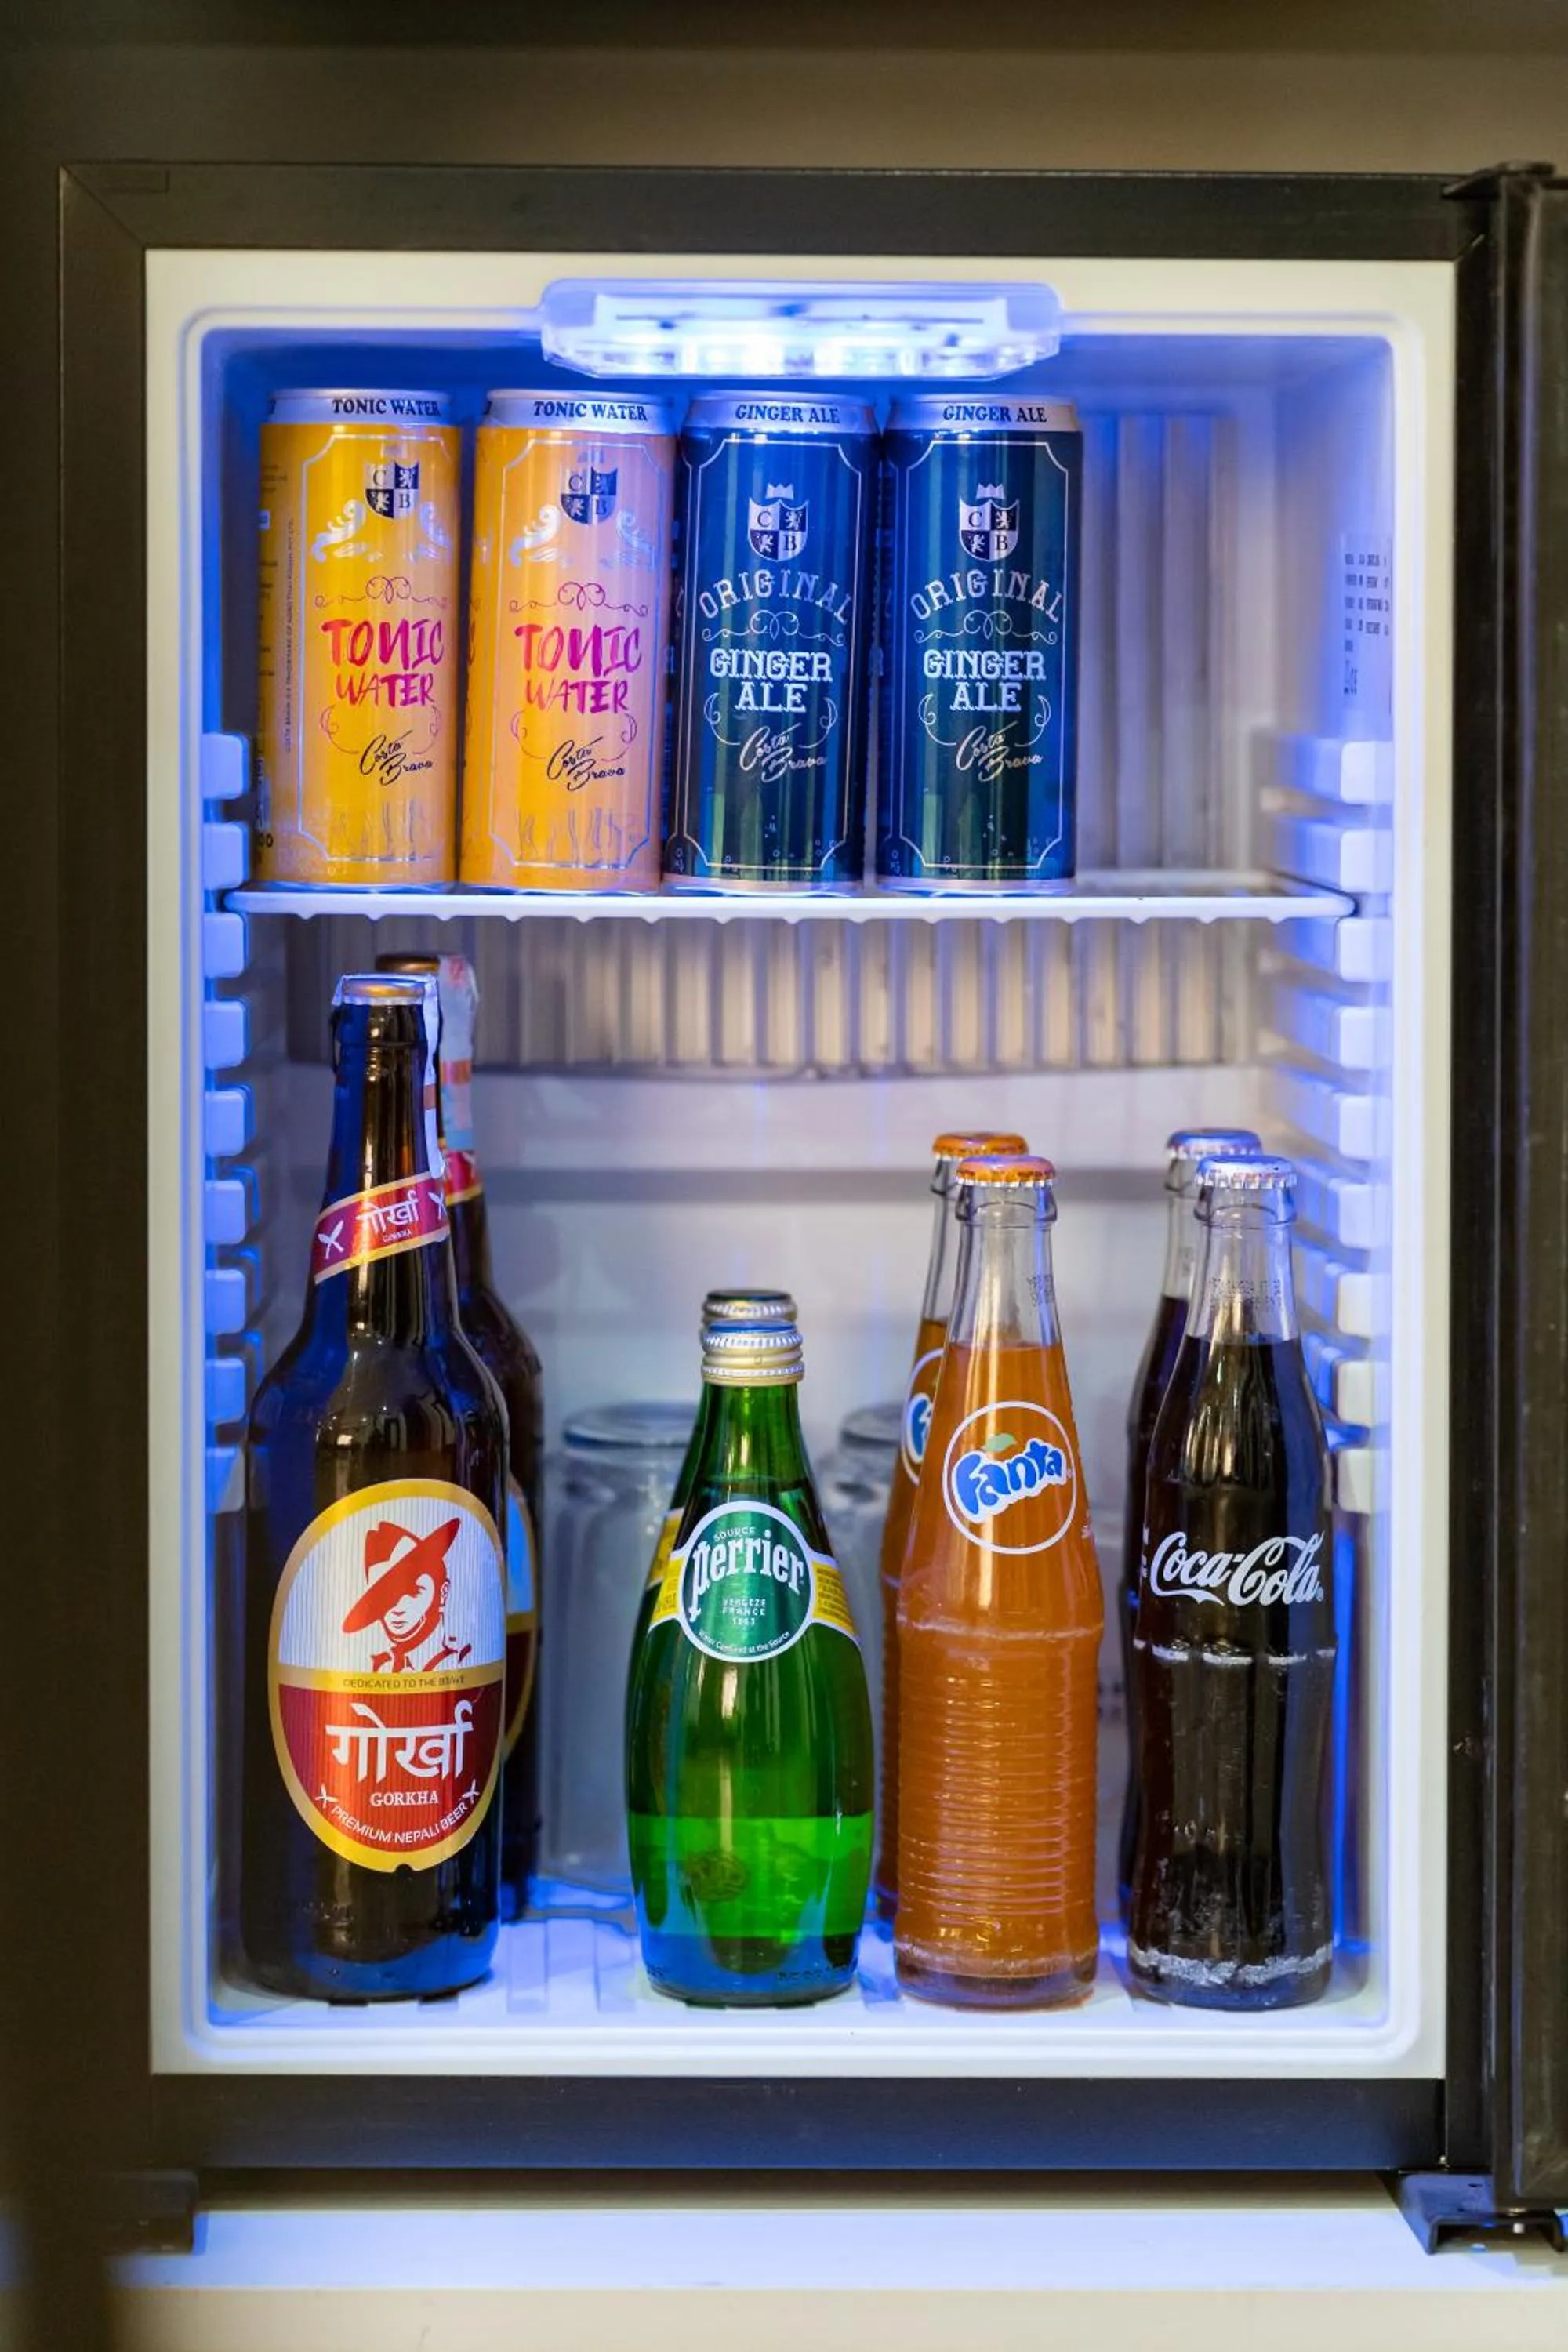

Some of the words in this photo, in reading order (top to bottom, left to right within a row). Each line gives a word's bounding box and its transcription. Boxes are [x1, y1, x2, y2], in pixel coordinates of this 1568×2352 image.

[332, 399, 387, 415] TONIC
[391, 400, 441, 416] WATER
[533, 401, 586, 417] TONIC
[592, 405, 648, 421] WATER
[735, 405, 804, 422] GINGER
[809, 407, 840, 423] ALE
[943, 405, 1011, 423] GINGER
[1016, 406, 1047, 423] ALE
[372, 470, 386, 486] C
[568, 475, 583, 492] C
[399, 493, 411, 509] B
[757, 510, 771, 528] C
[968, 511, 982, 528] C
[784, 535, 797, 551] B
[996, 535, 1008, 551] B
[699, 569, 851, 625] ORIGINAL
[910, 569, 1062, 623] ORIGINAL
[321, 619, 444, 670] TONIC
[514, 624, 642, 677] TONIC
[710, 648, 833, 682] GINGER
[924, 648, 1047, 681] GINGER
[336, 673, 434, 707] WATER
[526, 679, 628, 714] WATER
[735, 681, 808, 713] ALE
[950, 681, 1022, 712] ALE
[954, 1439, 1065, 1521] Fanta
[713, 1526, 756, 1542] SOURCE
[1150, 1530, 1325, 1606] Coca-Cola
[723, 1608, 766, 1617] FRANCE
[343, 1678, 401, 1690] DEDICATED
[403, 1679, 416, 1689] TO
[419, 1677, 437, 1687] THE
[370, 1790, 439, 1807] GORKHA
[331, 1805, 391, 1842] PREMIUM
[394, 1825, 440, 1844] NEPALI
[441, 1802, 468, 1831] BEER
